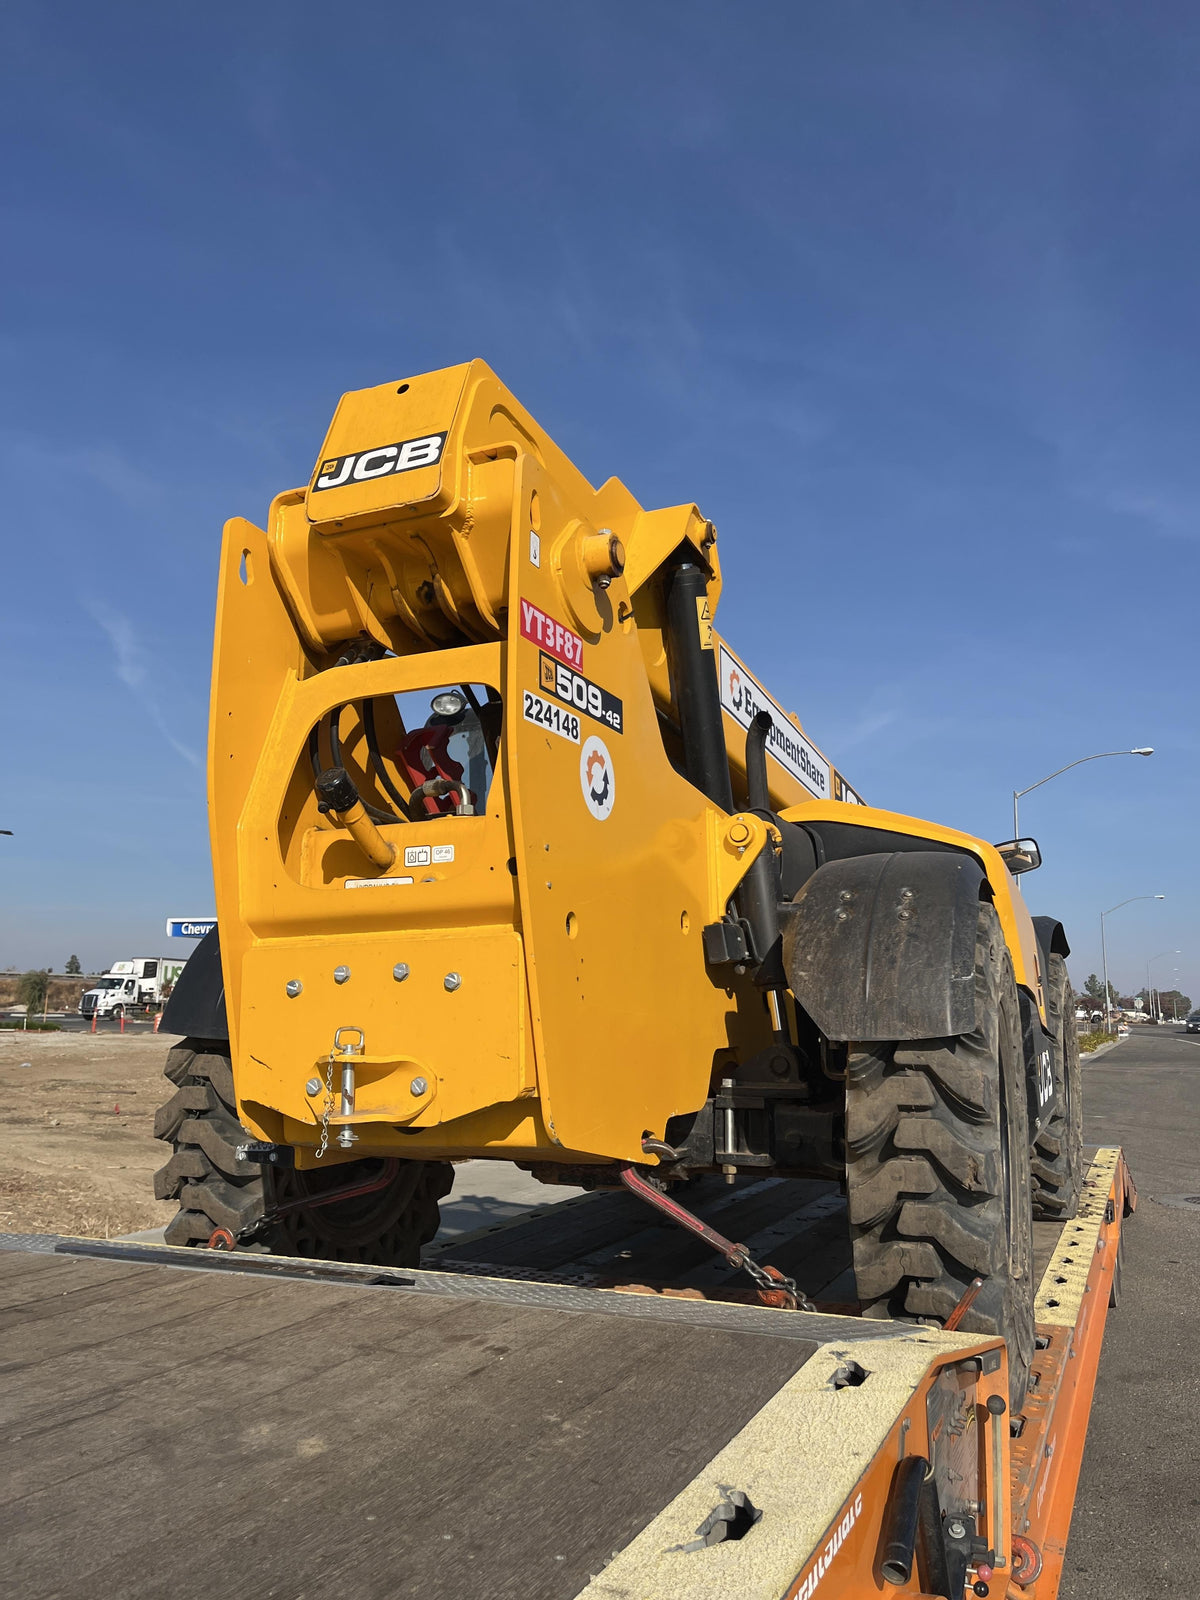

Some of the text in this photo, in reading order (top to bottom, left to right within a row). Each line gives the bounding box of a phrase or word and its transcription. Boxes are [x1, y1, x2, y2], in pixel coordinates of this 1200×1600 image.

[317, 436, 442, 488] JCB
[522, 600, 583, 665] YT3F87
[524, 693, 579, 740] 224148
[744, 685, 826, 792] EqpmentShare
[181, 922, 215, 935] Chevr
